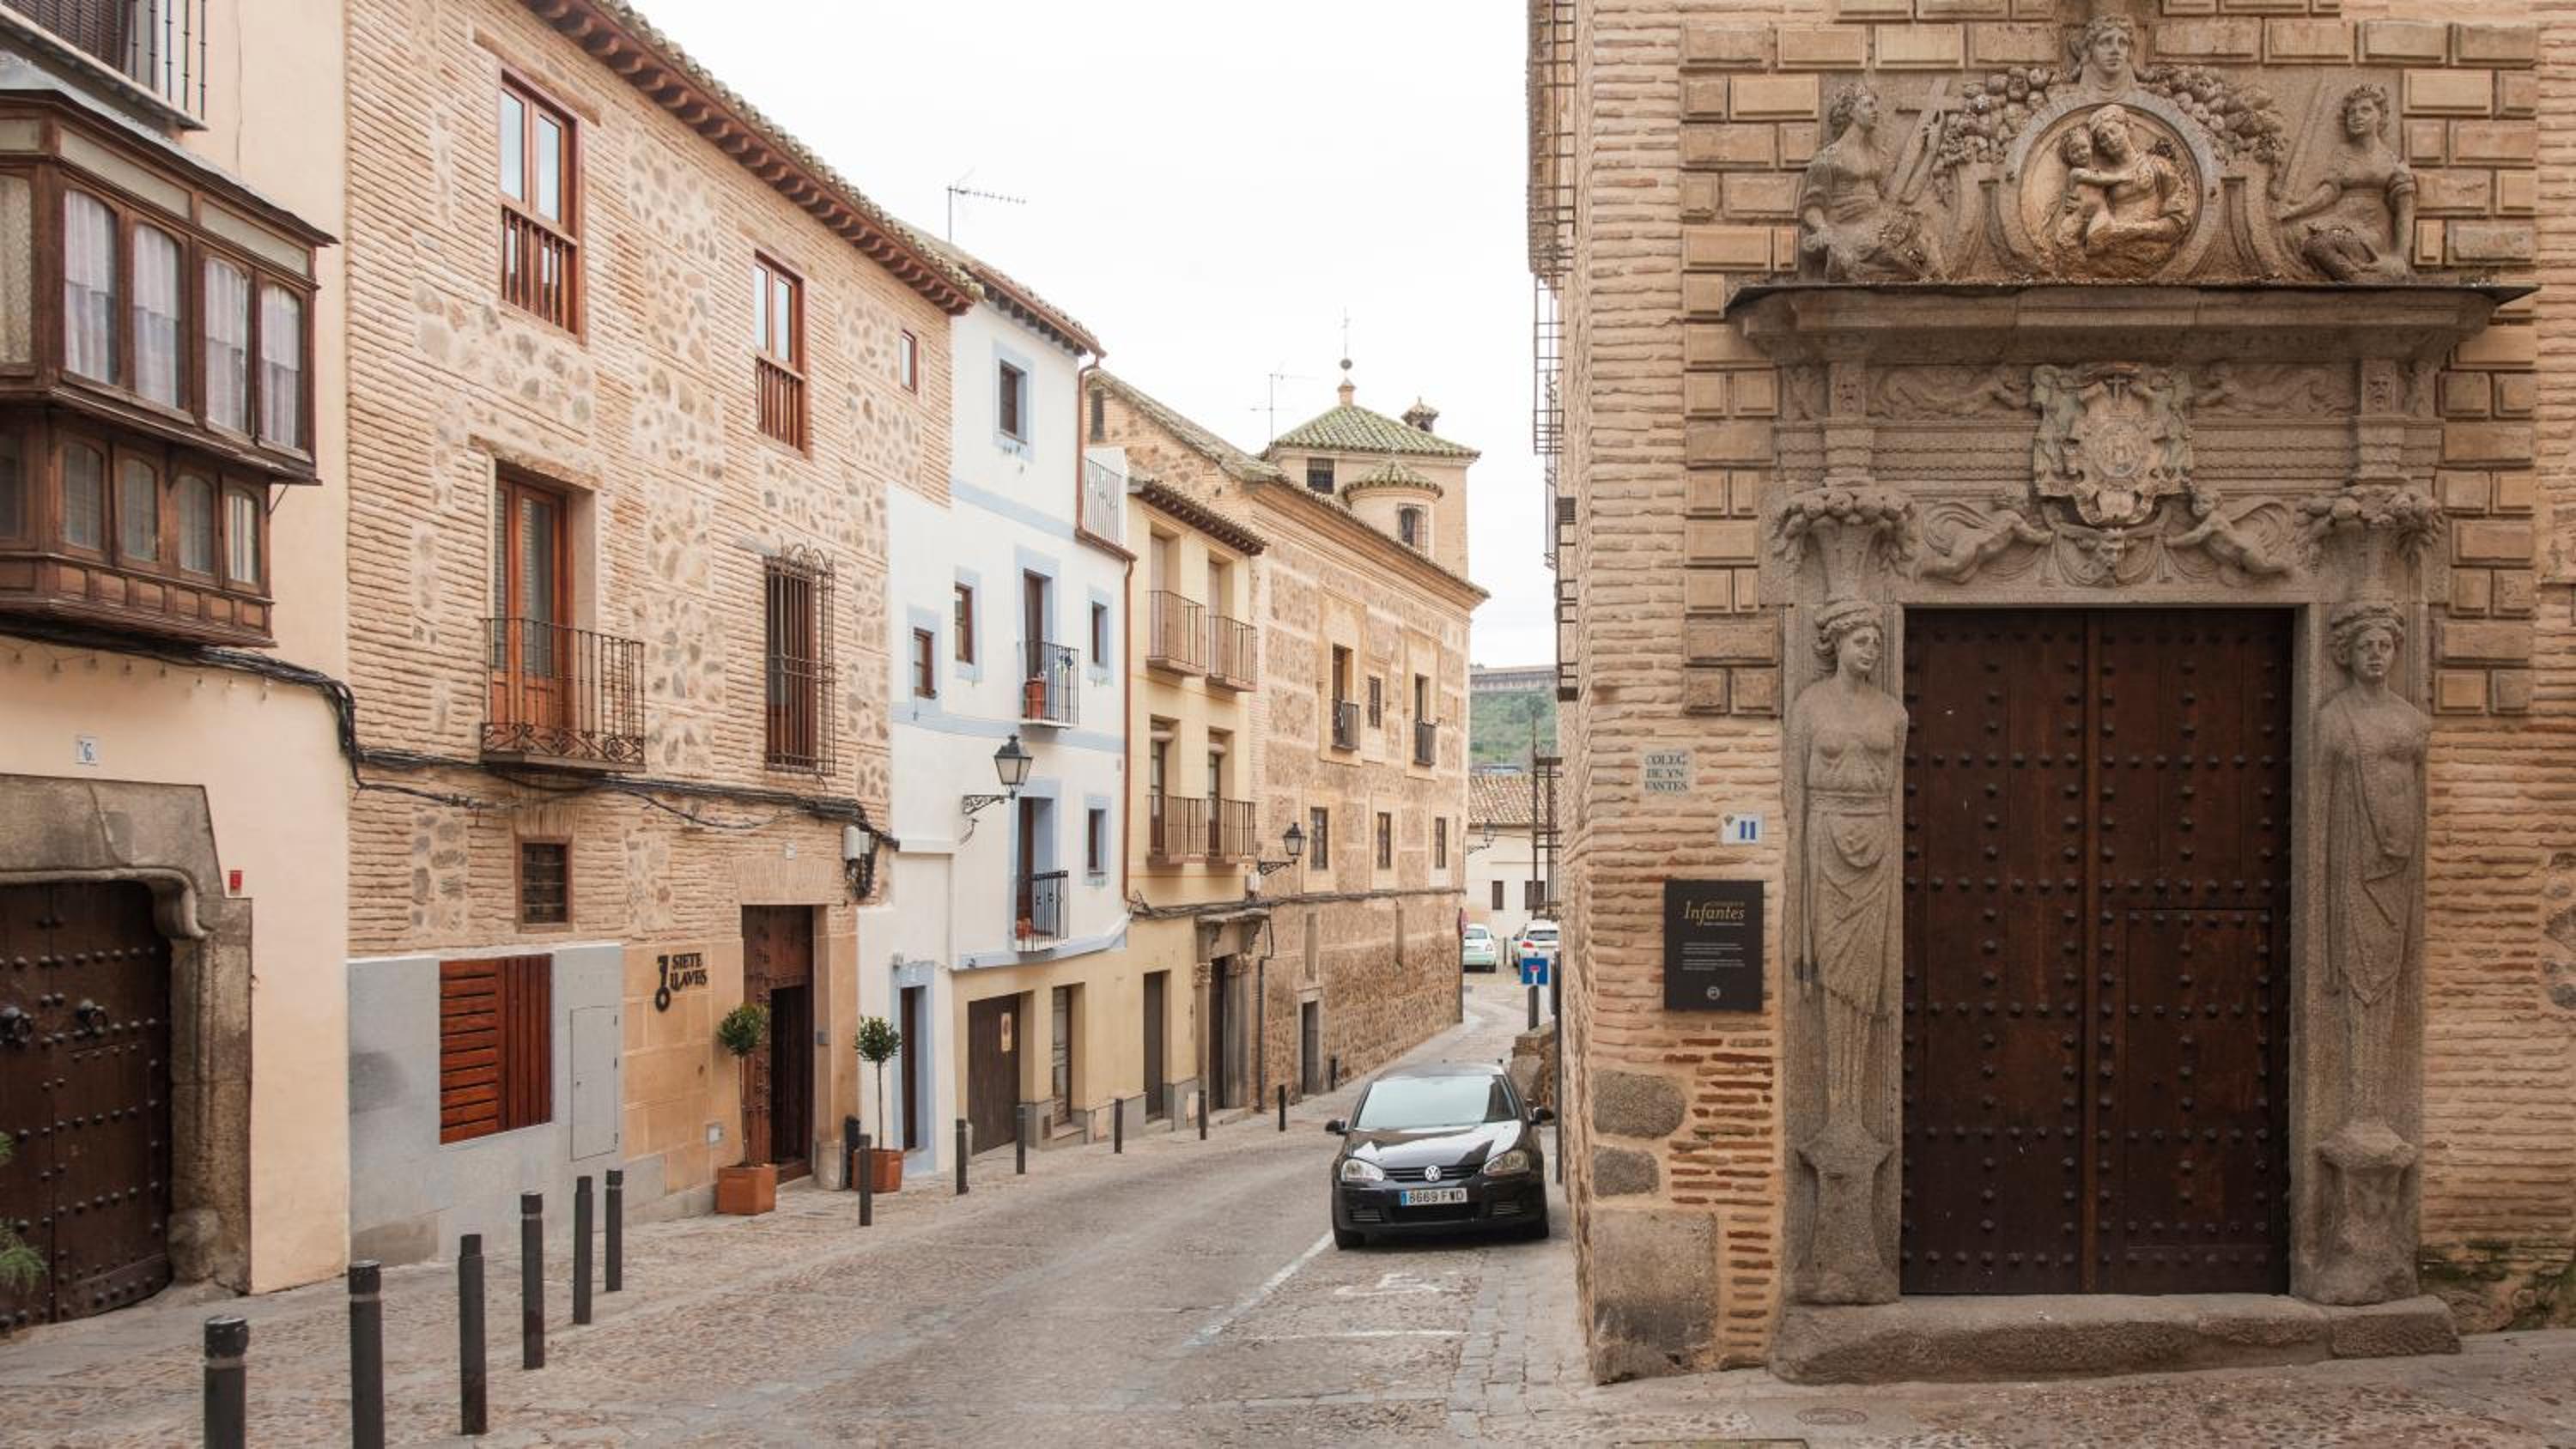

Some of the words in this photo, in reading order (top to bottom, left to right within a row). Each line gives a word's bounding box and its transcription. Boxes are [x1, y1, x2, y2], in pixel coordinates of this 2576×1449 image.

[1646, 768, 1662, 779] DE
[1684, 900, 1745, 926] Infantes
[672, 952, 703, 969] SIETE
